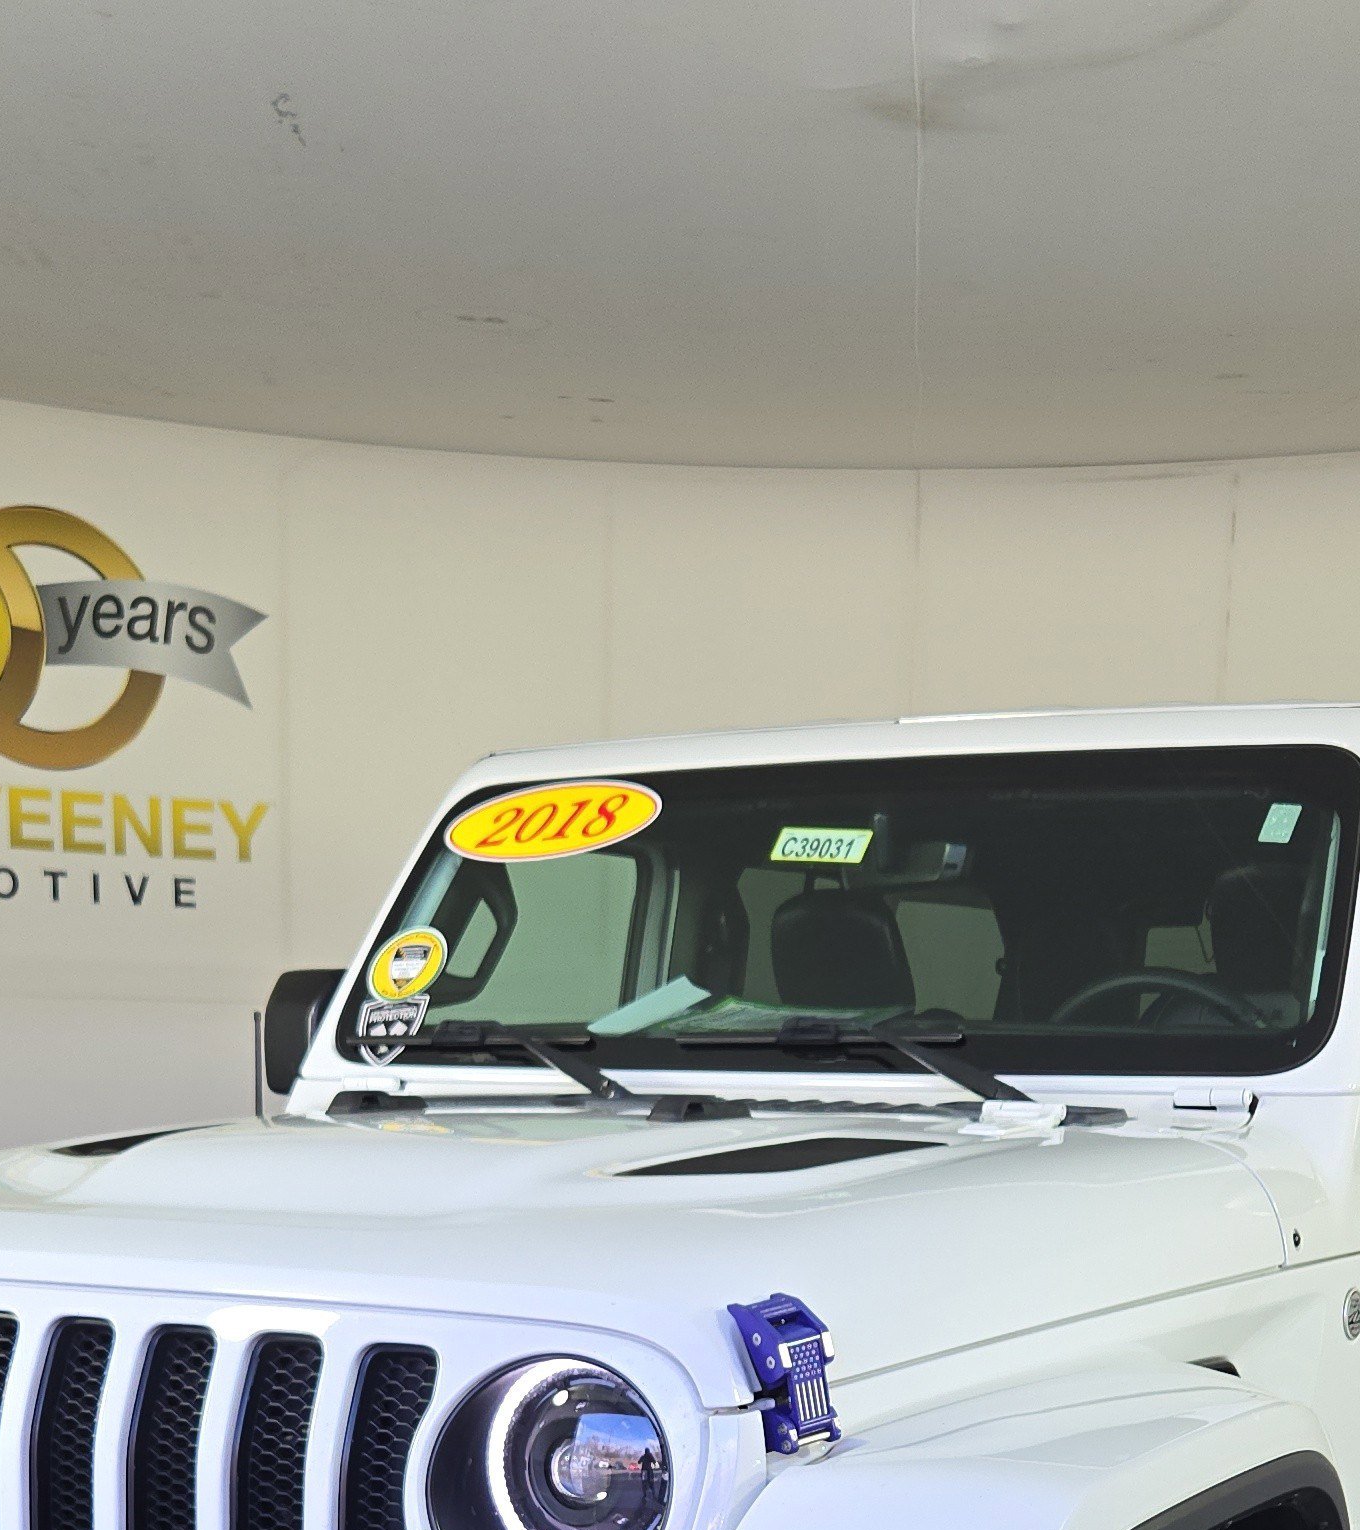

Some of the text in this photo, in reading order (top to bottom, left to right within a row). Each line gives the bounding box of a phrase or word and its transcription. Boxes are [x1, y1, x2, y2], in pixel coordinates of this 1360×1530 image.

[57, 591, 217, 654] years
[475, 793, 630, 848] 2018
[781, 836, 856, 860] C39031
